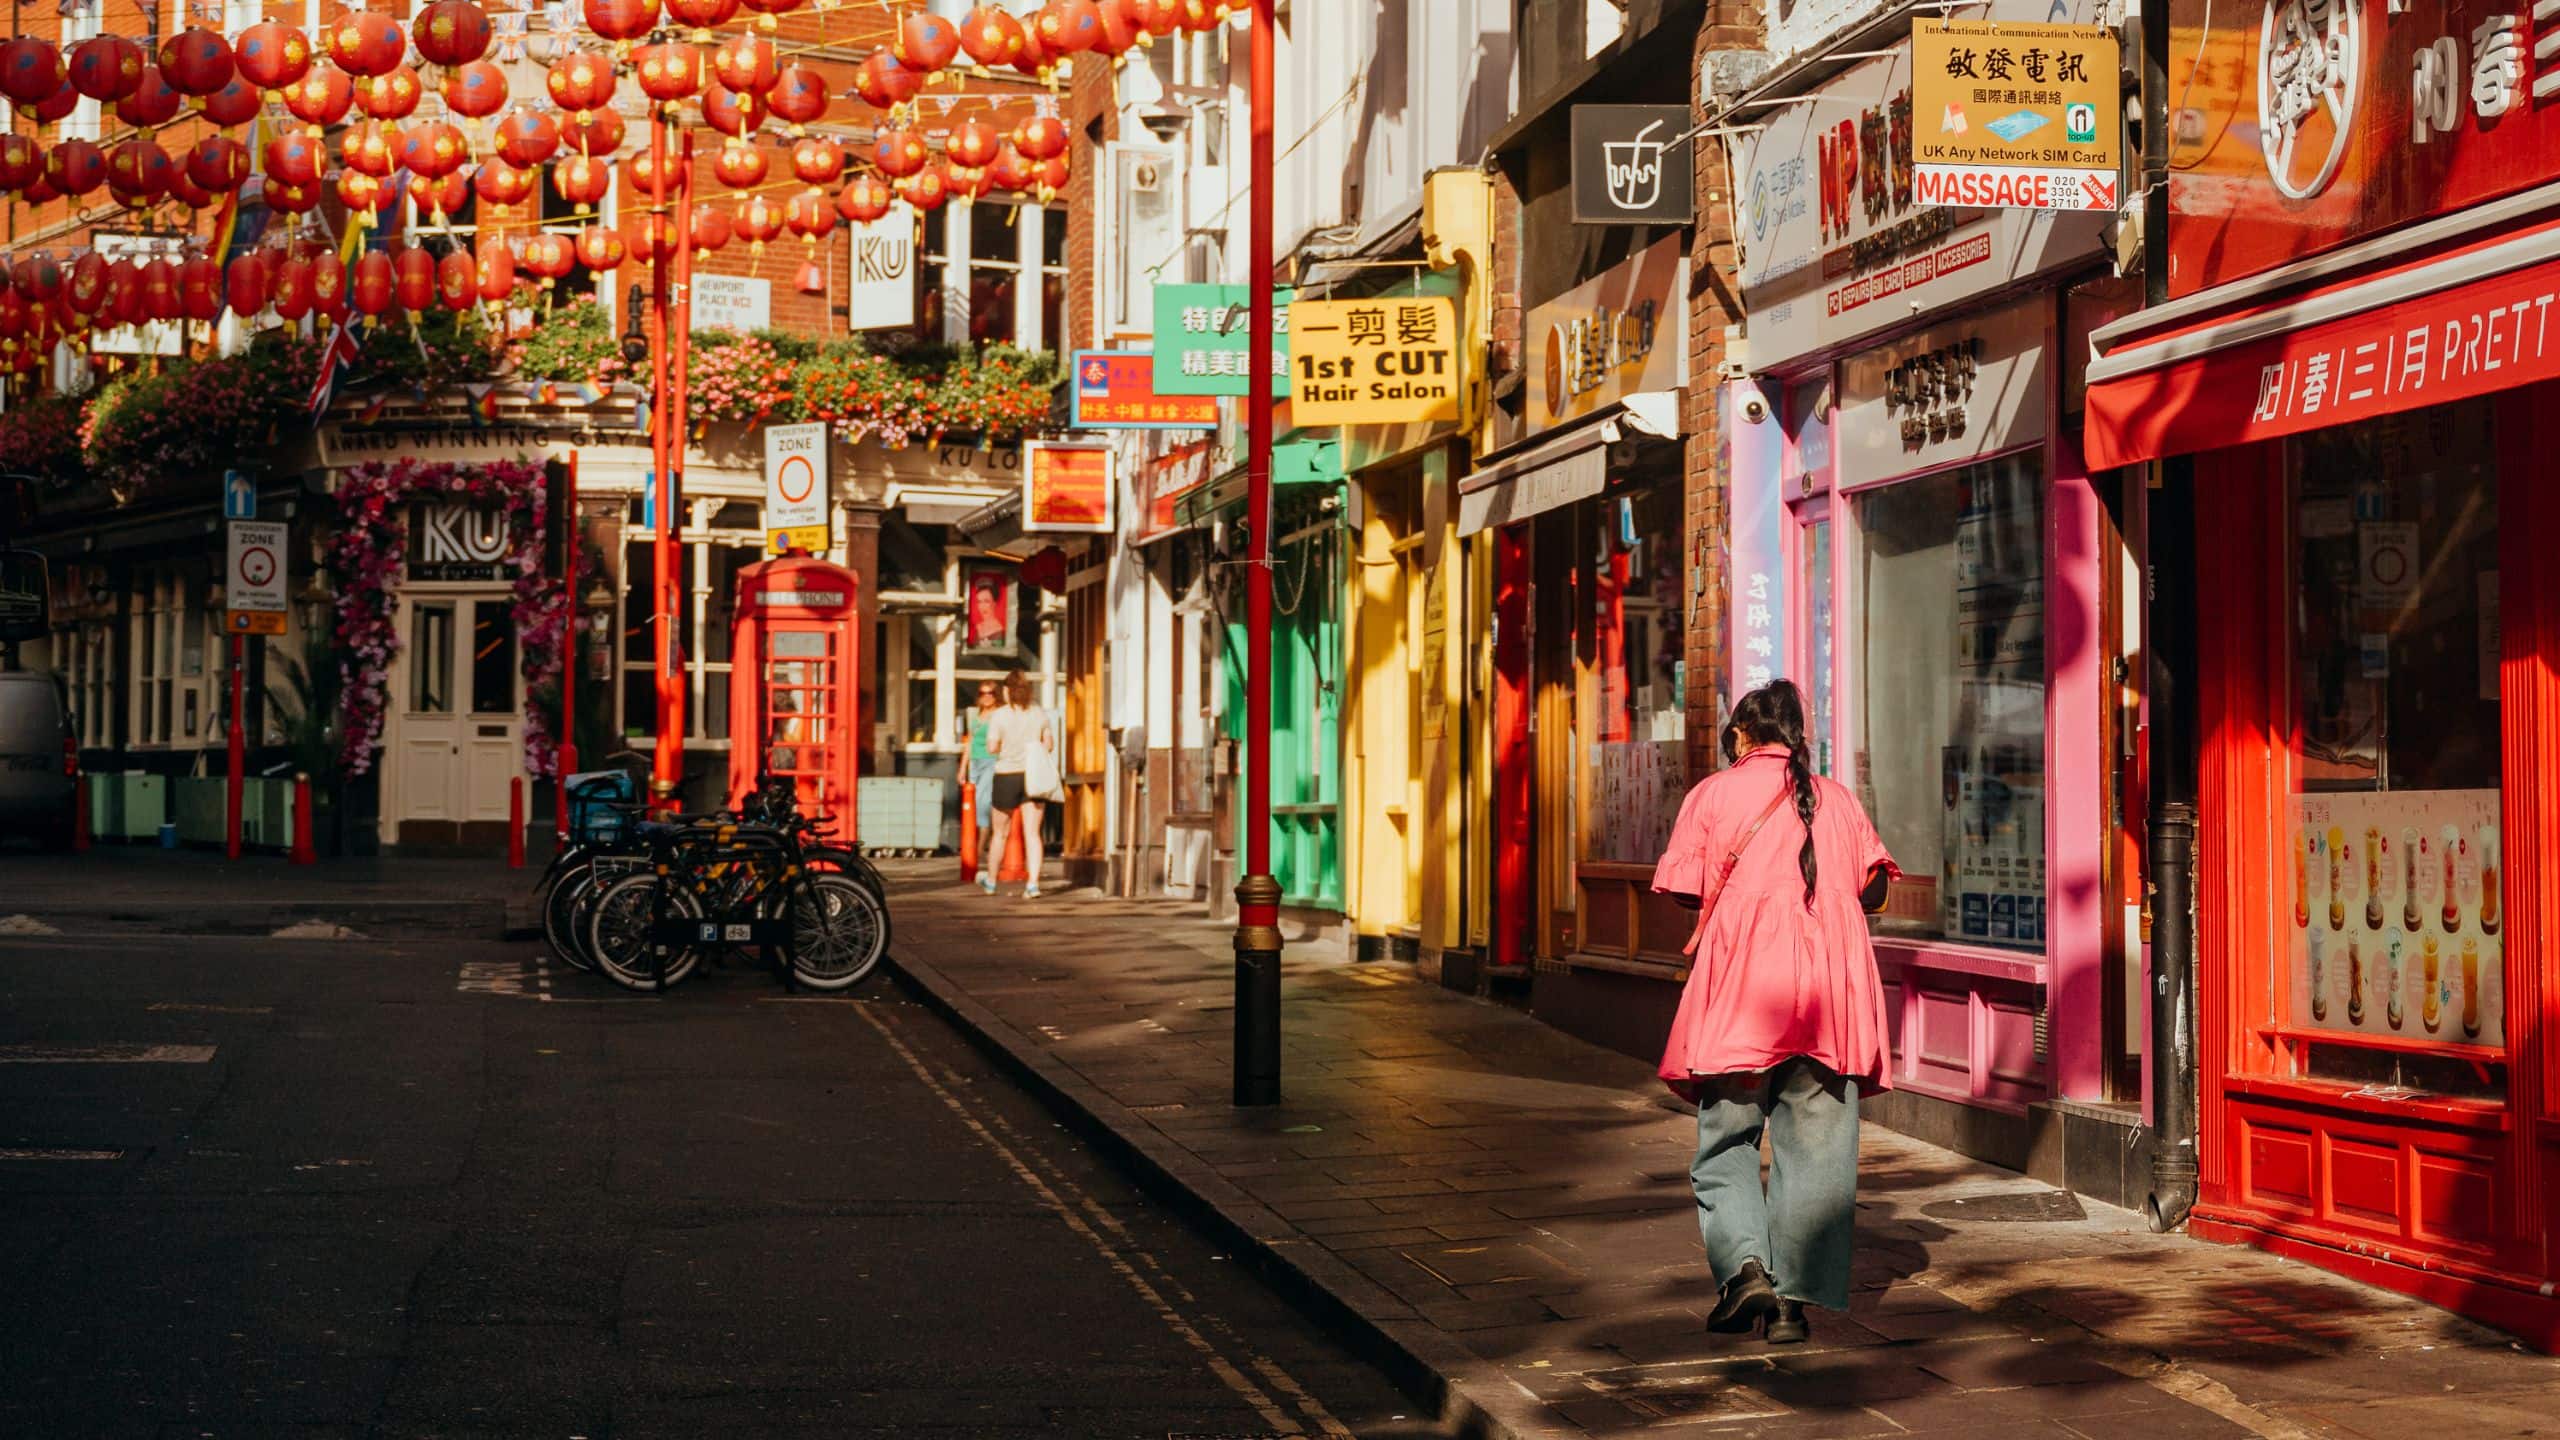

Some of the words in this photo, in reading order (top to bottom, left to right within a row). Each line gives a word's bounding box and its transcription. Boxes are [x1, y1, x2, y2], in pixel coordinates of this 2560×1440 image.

[1925, 25, 1989, 37] Intenational
[1992, 26, 2069, 39] Communication
[1946, 48, 2088, 83] 敏發電訊
[1973, 89, 2061, 105] 國際通訊網絡
[2068, 133, 2095, 142] top-up
[1923, 146, 1944, 158] UK
[1949, 146, 1975, 161] Any
[1980, 147, 2039, 161] Network
[2043, 150, 2068, 162] SIM
[2073, 151, 2106, 164] Card
[1917, 172, 2049, 207] MASSAGE
[2054, 176, 2076, 186] 020
[2051, 187, 2079, 197] 3304
[2051, 198, 2079, 208] 3710
[858, 236, 907, 283] KU
[1843, 280, 1870, 309] REPAIRS
[1937, 236, 1989, 272] ACCESSORIES
[1302, 305, 1437, 346] 一剪髮
[2441, 293, 2560, 381] PRETT
[1297, 354, 1354, 379] 1st
[1374, 350, 1448, 376] CUT
[1303, 384, 1358, 402] Hair
[1370, 382, 1446, 400] Salon
[329, 436, 398, 451] AWARD
[413, 430, 549, 448] WINNING
[571, 430, 636, 447] GAY
[778, 438, 813, 451] ZONE
[939, 448, 973, 467] KU
[241, 533, 275, 545] ZONE
[424, 506, 510, 562] KU
[703, 927, 715, 939] P
